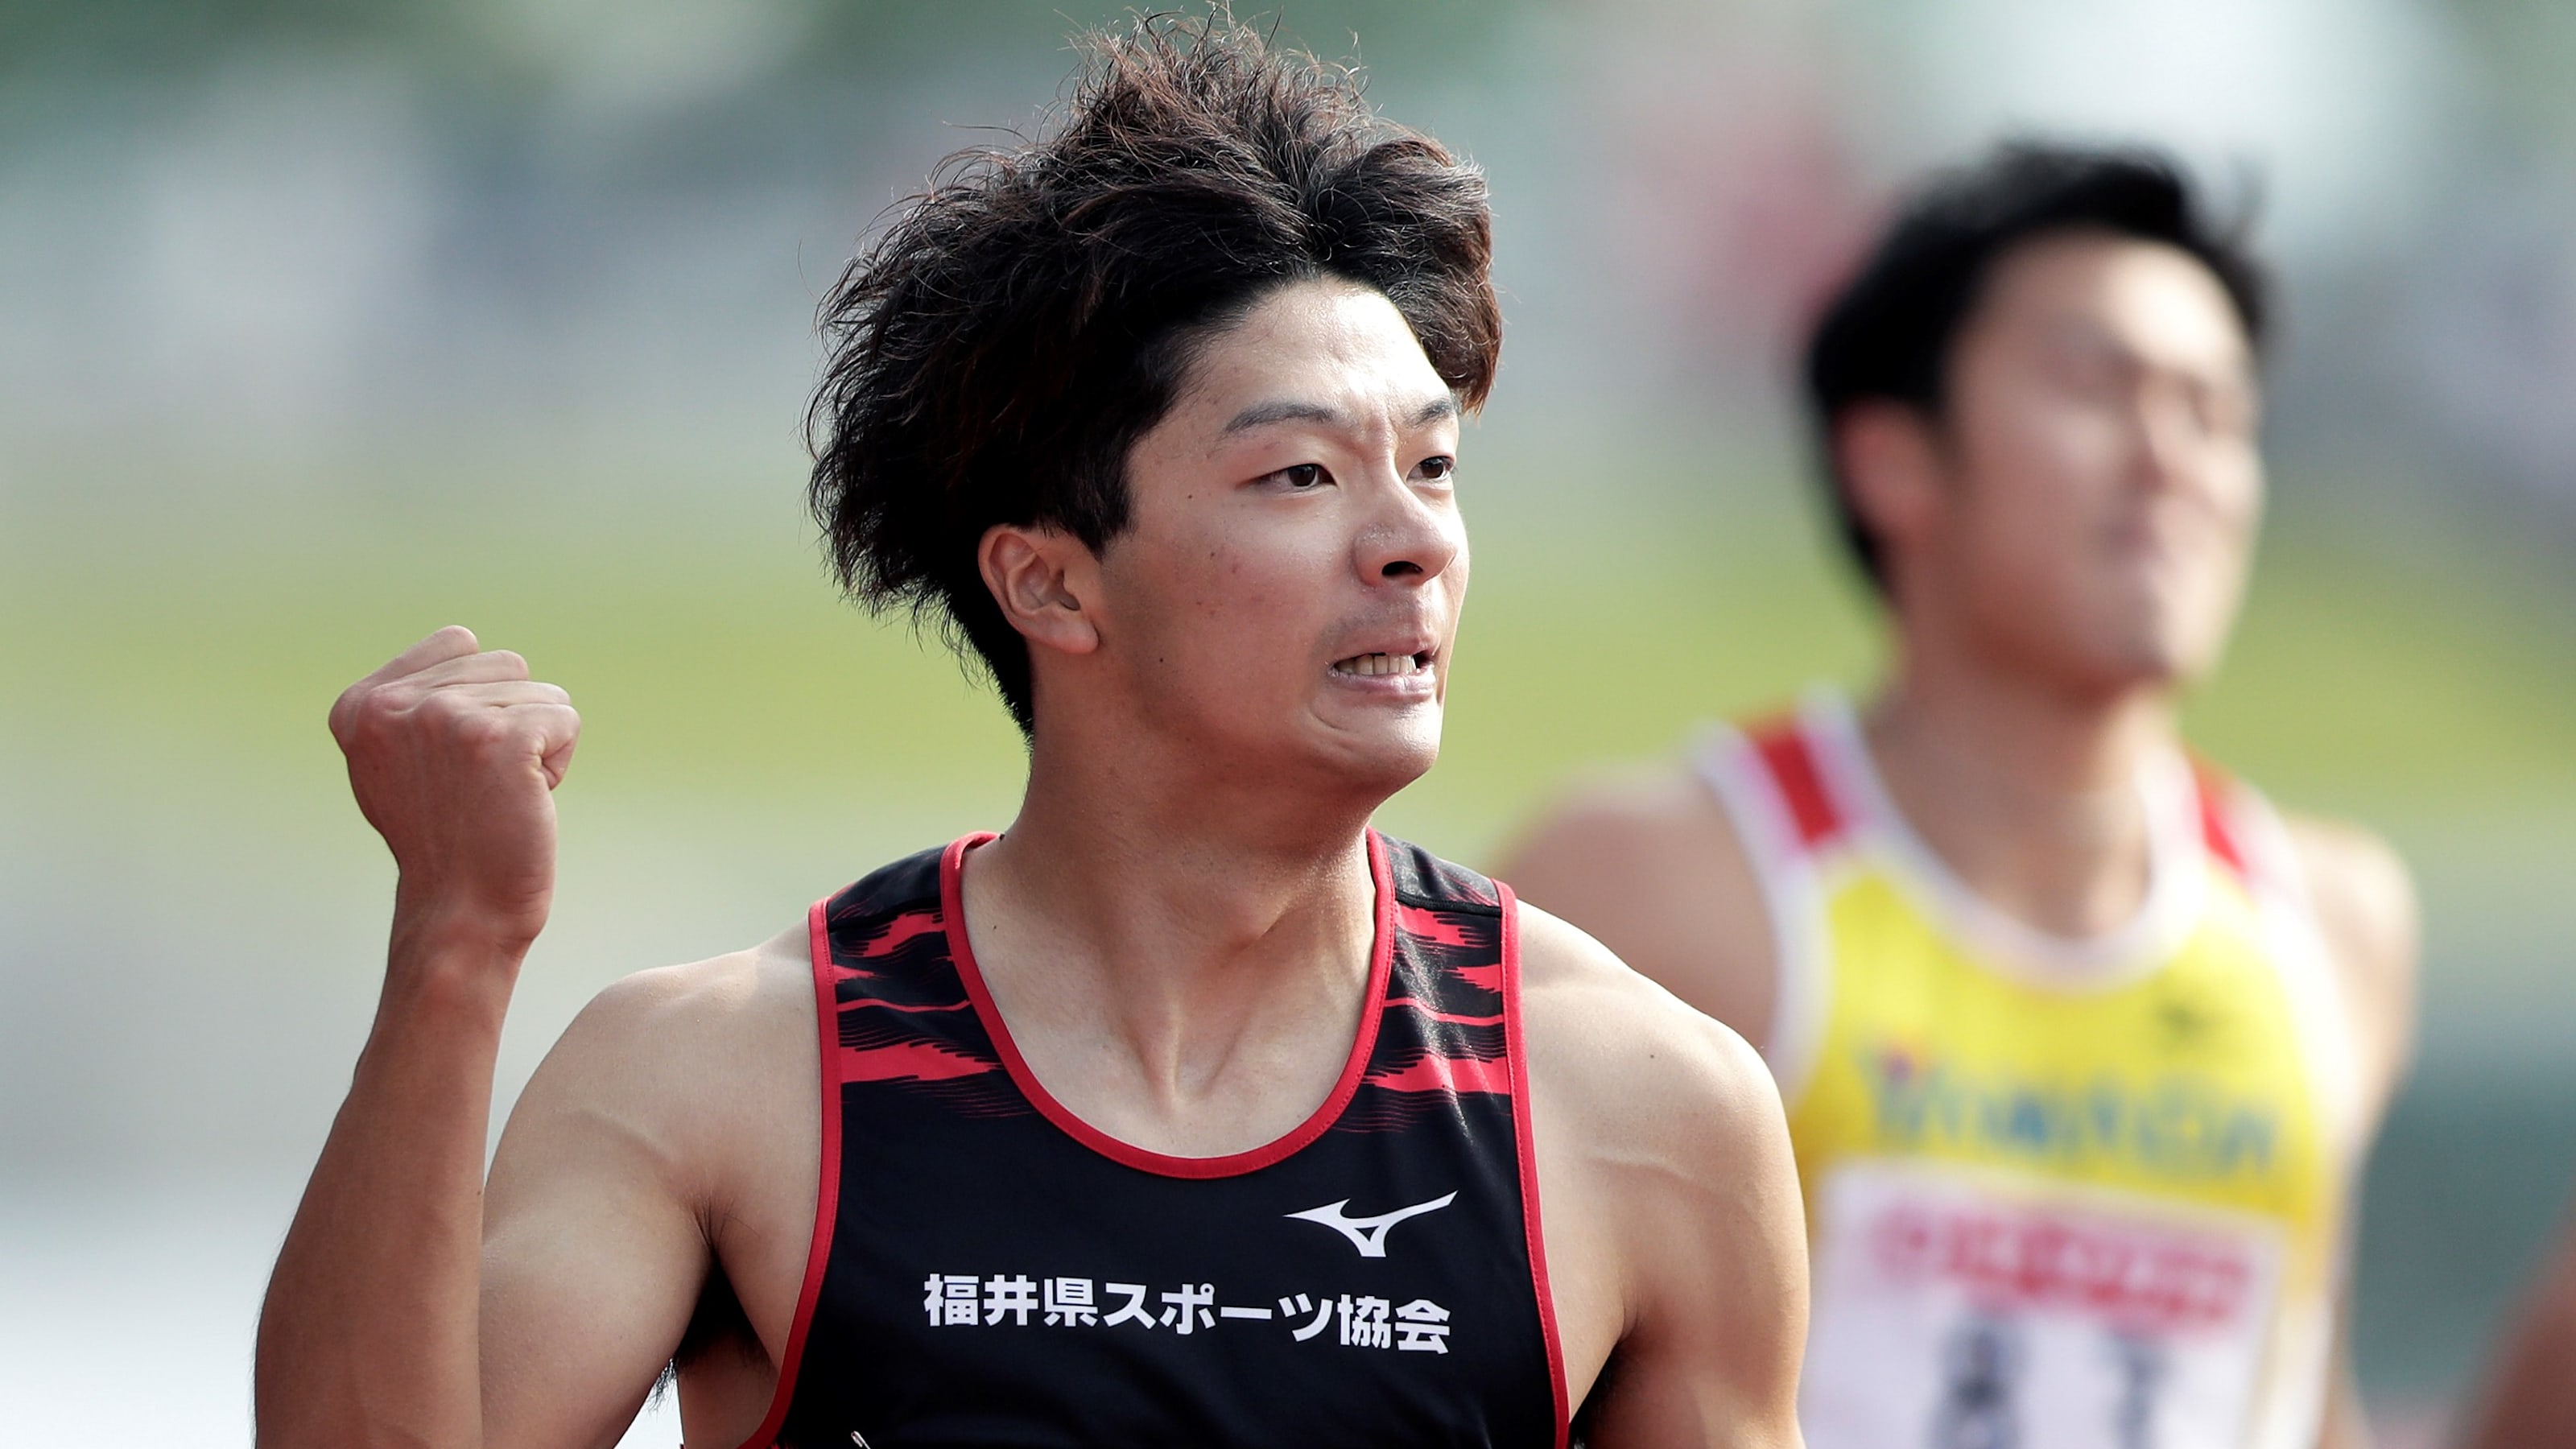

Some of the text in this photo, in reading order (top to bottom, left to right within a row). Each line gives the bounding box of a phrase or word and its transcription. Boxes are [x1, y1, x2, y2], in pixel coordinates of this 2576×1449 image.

[923, 1273, 1451, 1355] 福井県スポーツ協会
